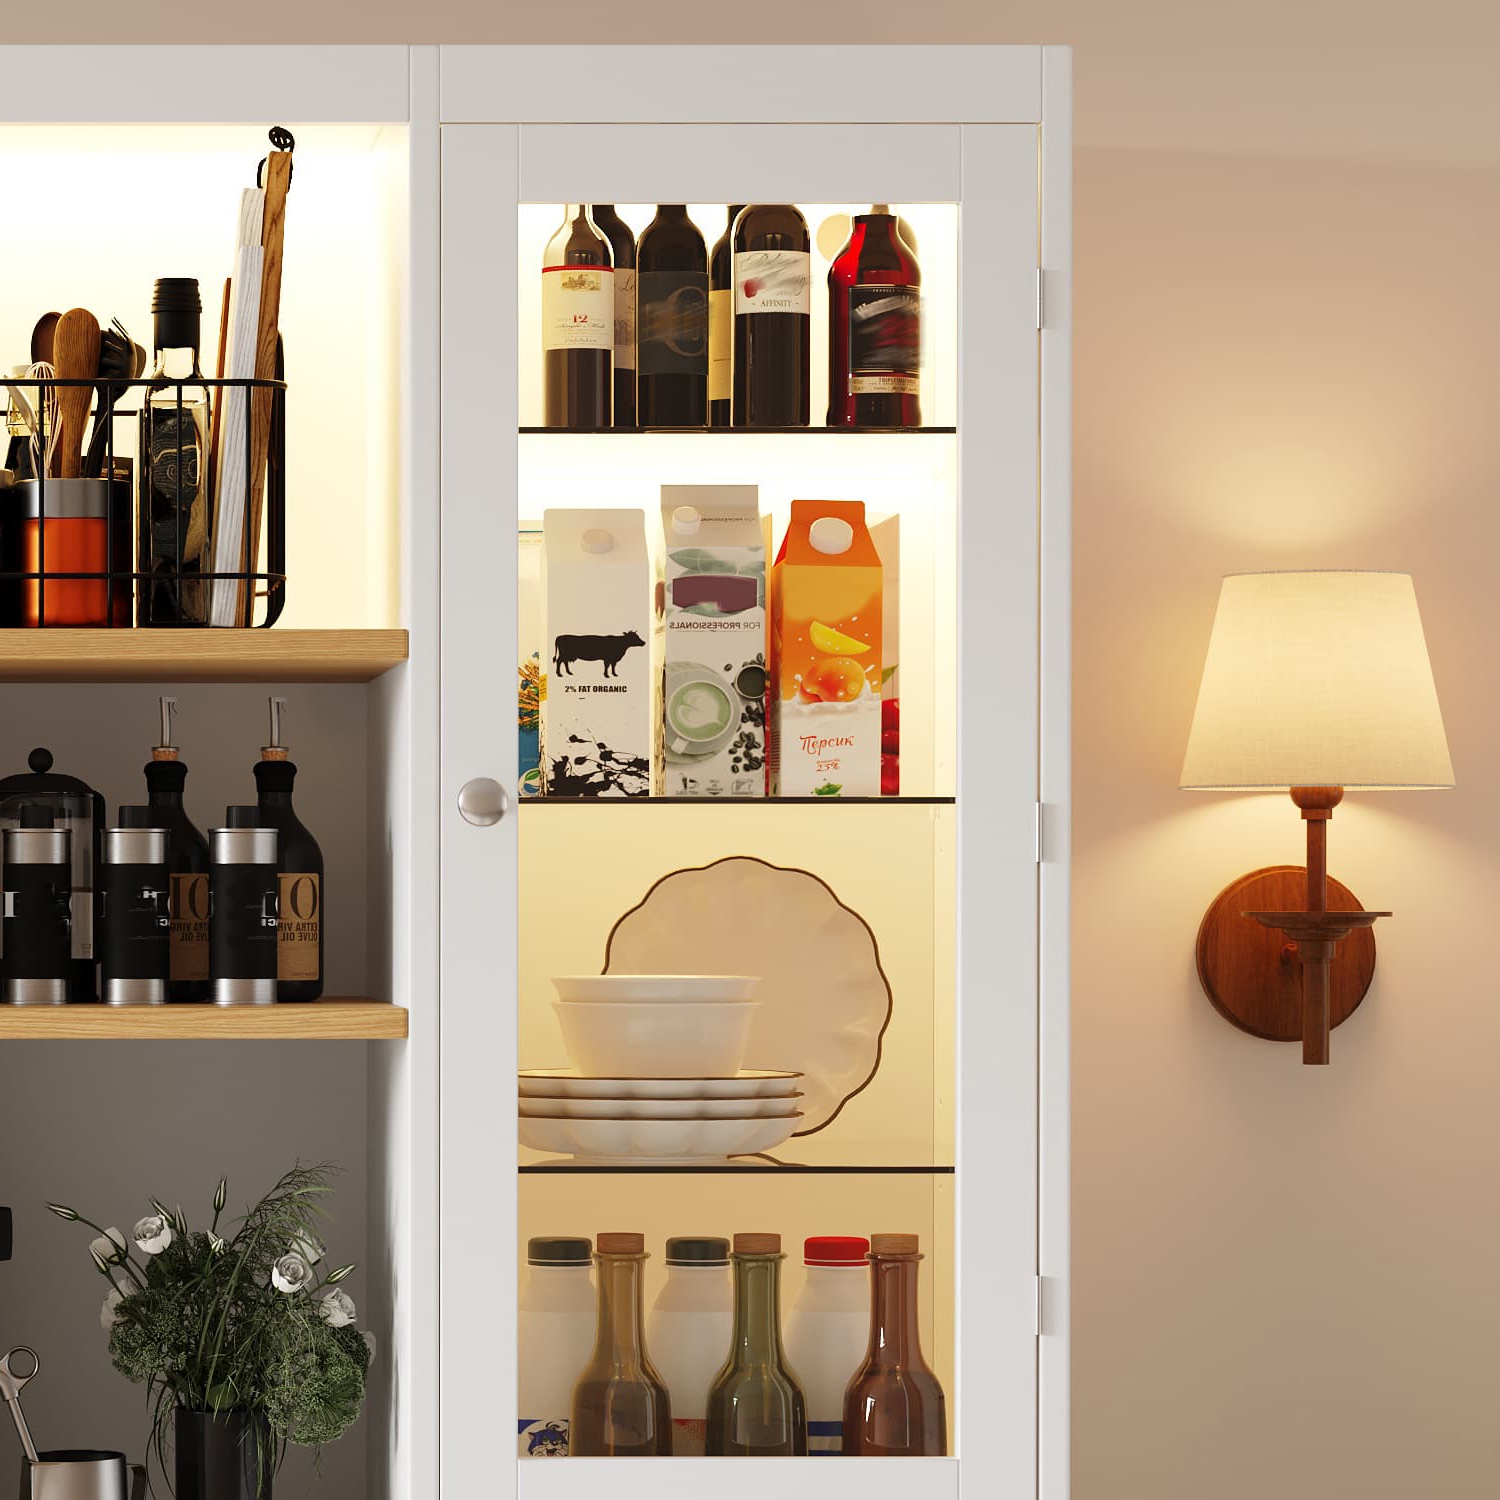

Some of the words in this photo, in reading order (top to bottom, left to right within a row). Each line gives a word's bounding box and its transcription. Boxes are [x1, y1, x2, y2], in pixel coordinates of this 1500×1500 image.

[760, 299, 792, 308] AFFINITY
[573, 314, 589, 323] 12
[564, 685, 577, 693] 2%
[578, 685, 591, 693] FAT
[592, 685, 628, 693] ORGANIC
[799, 735, 855, 756] Персик
